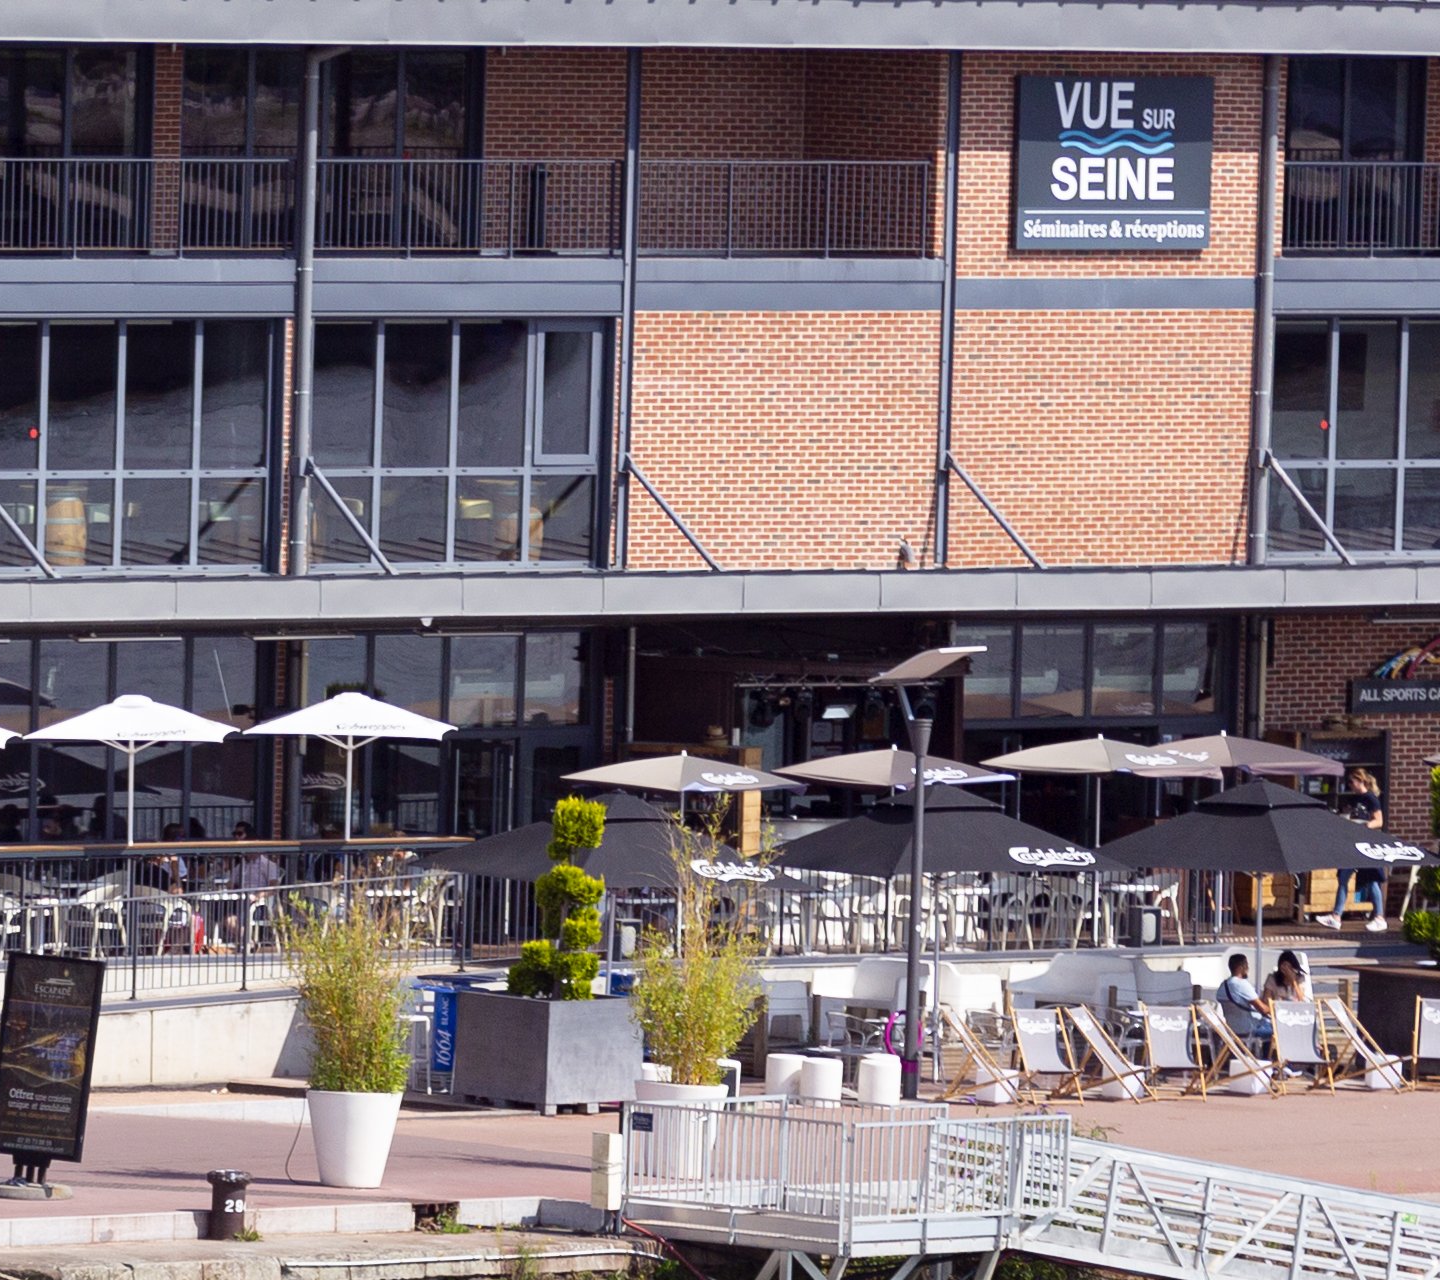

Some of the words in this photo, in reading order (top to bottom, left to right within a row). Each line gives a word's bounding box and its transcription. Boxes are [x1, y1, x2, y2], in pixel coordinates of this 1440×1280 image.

[1054, 81, 1135, 129] VUE
[1142, 108, 1175, 129] SUR
[1050, 156, 1175, 200] SEINE
[1023, 218, 1107, 239] Séminaires
[1109, 219, 1122, 238] &
[1124, 218, 1205, 243] réceptions
[1359, 688, 1380, 702] ALL
[1382, 686, 1427, 702] SPORTS
[1008, 845, 1097, 868] Carlsberg
[689, 858, 776, 882] Carlsberg
[34, 983, 73, 997] ESCAPADE
[440, 996, 450, 1026] BLANC
[435, 1029, 453, 1066] 1664
